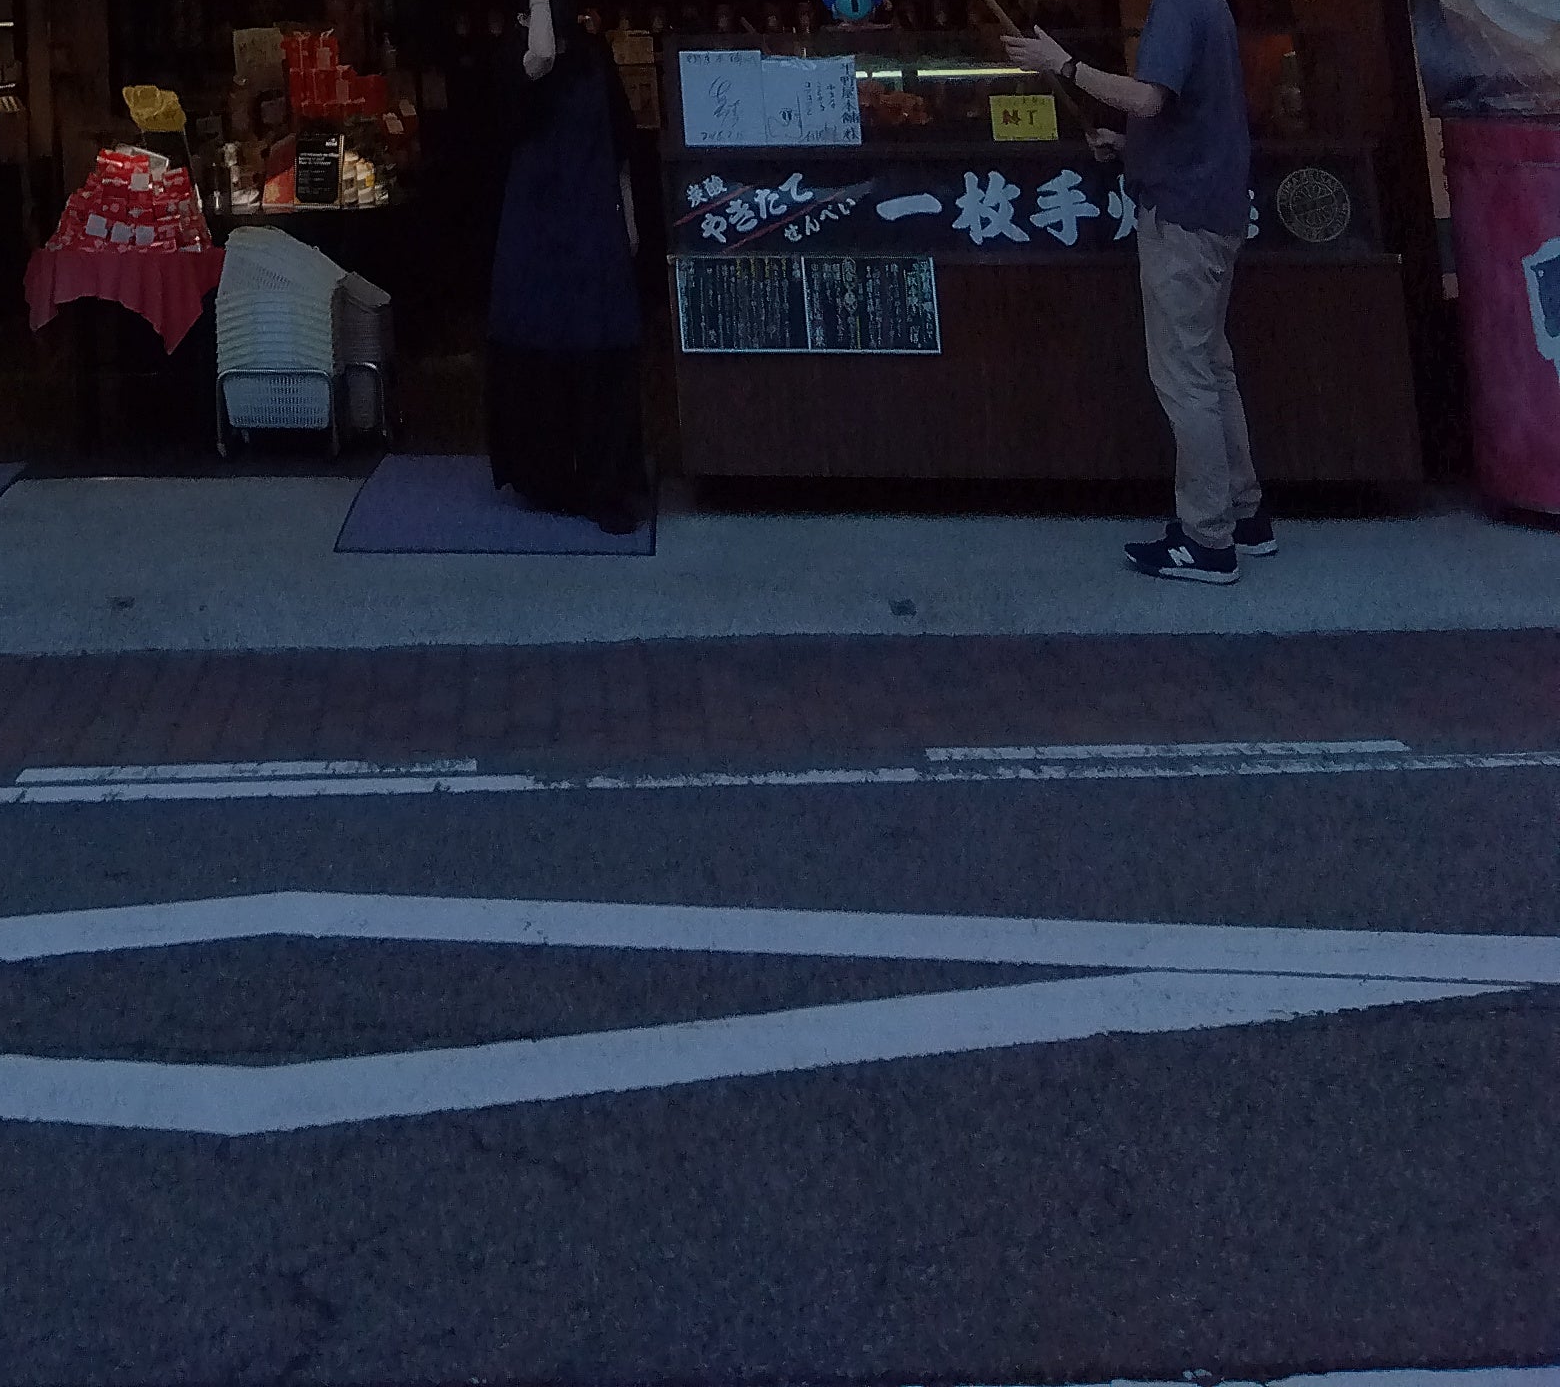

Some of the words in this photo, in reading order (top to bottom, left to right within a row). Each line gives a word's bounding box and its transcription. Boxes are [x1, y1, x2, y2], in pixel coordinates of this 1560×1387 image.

[700, 171, 814, 244] やきたて
[783, 197, 856, 243] せんべい
